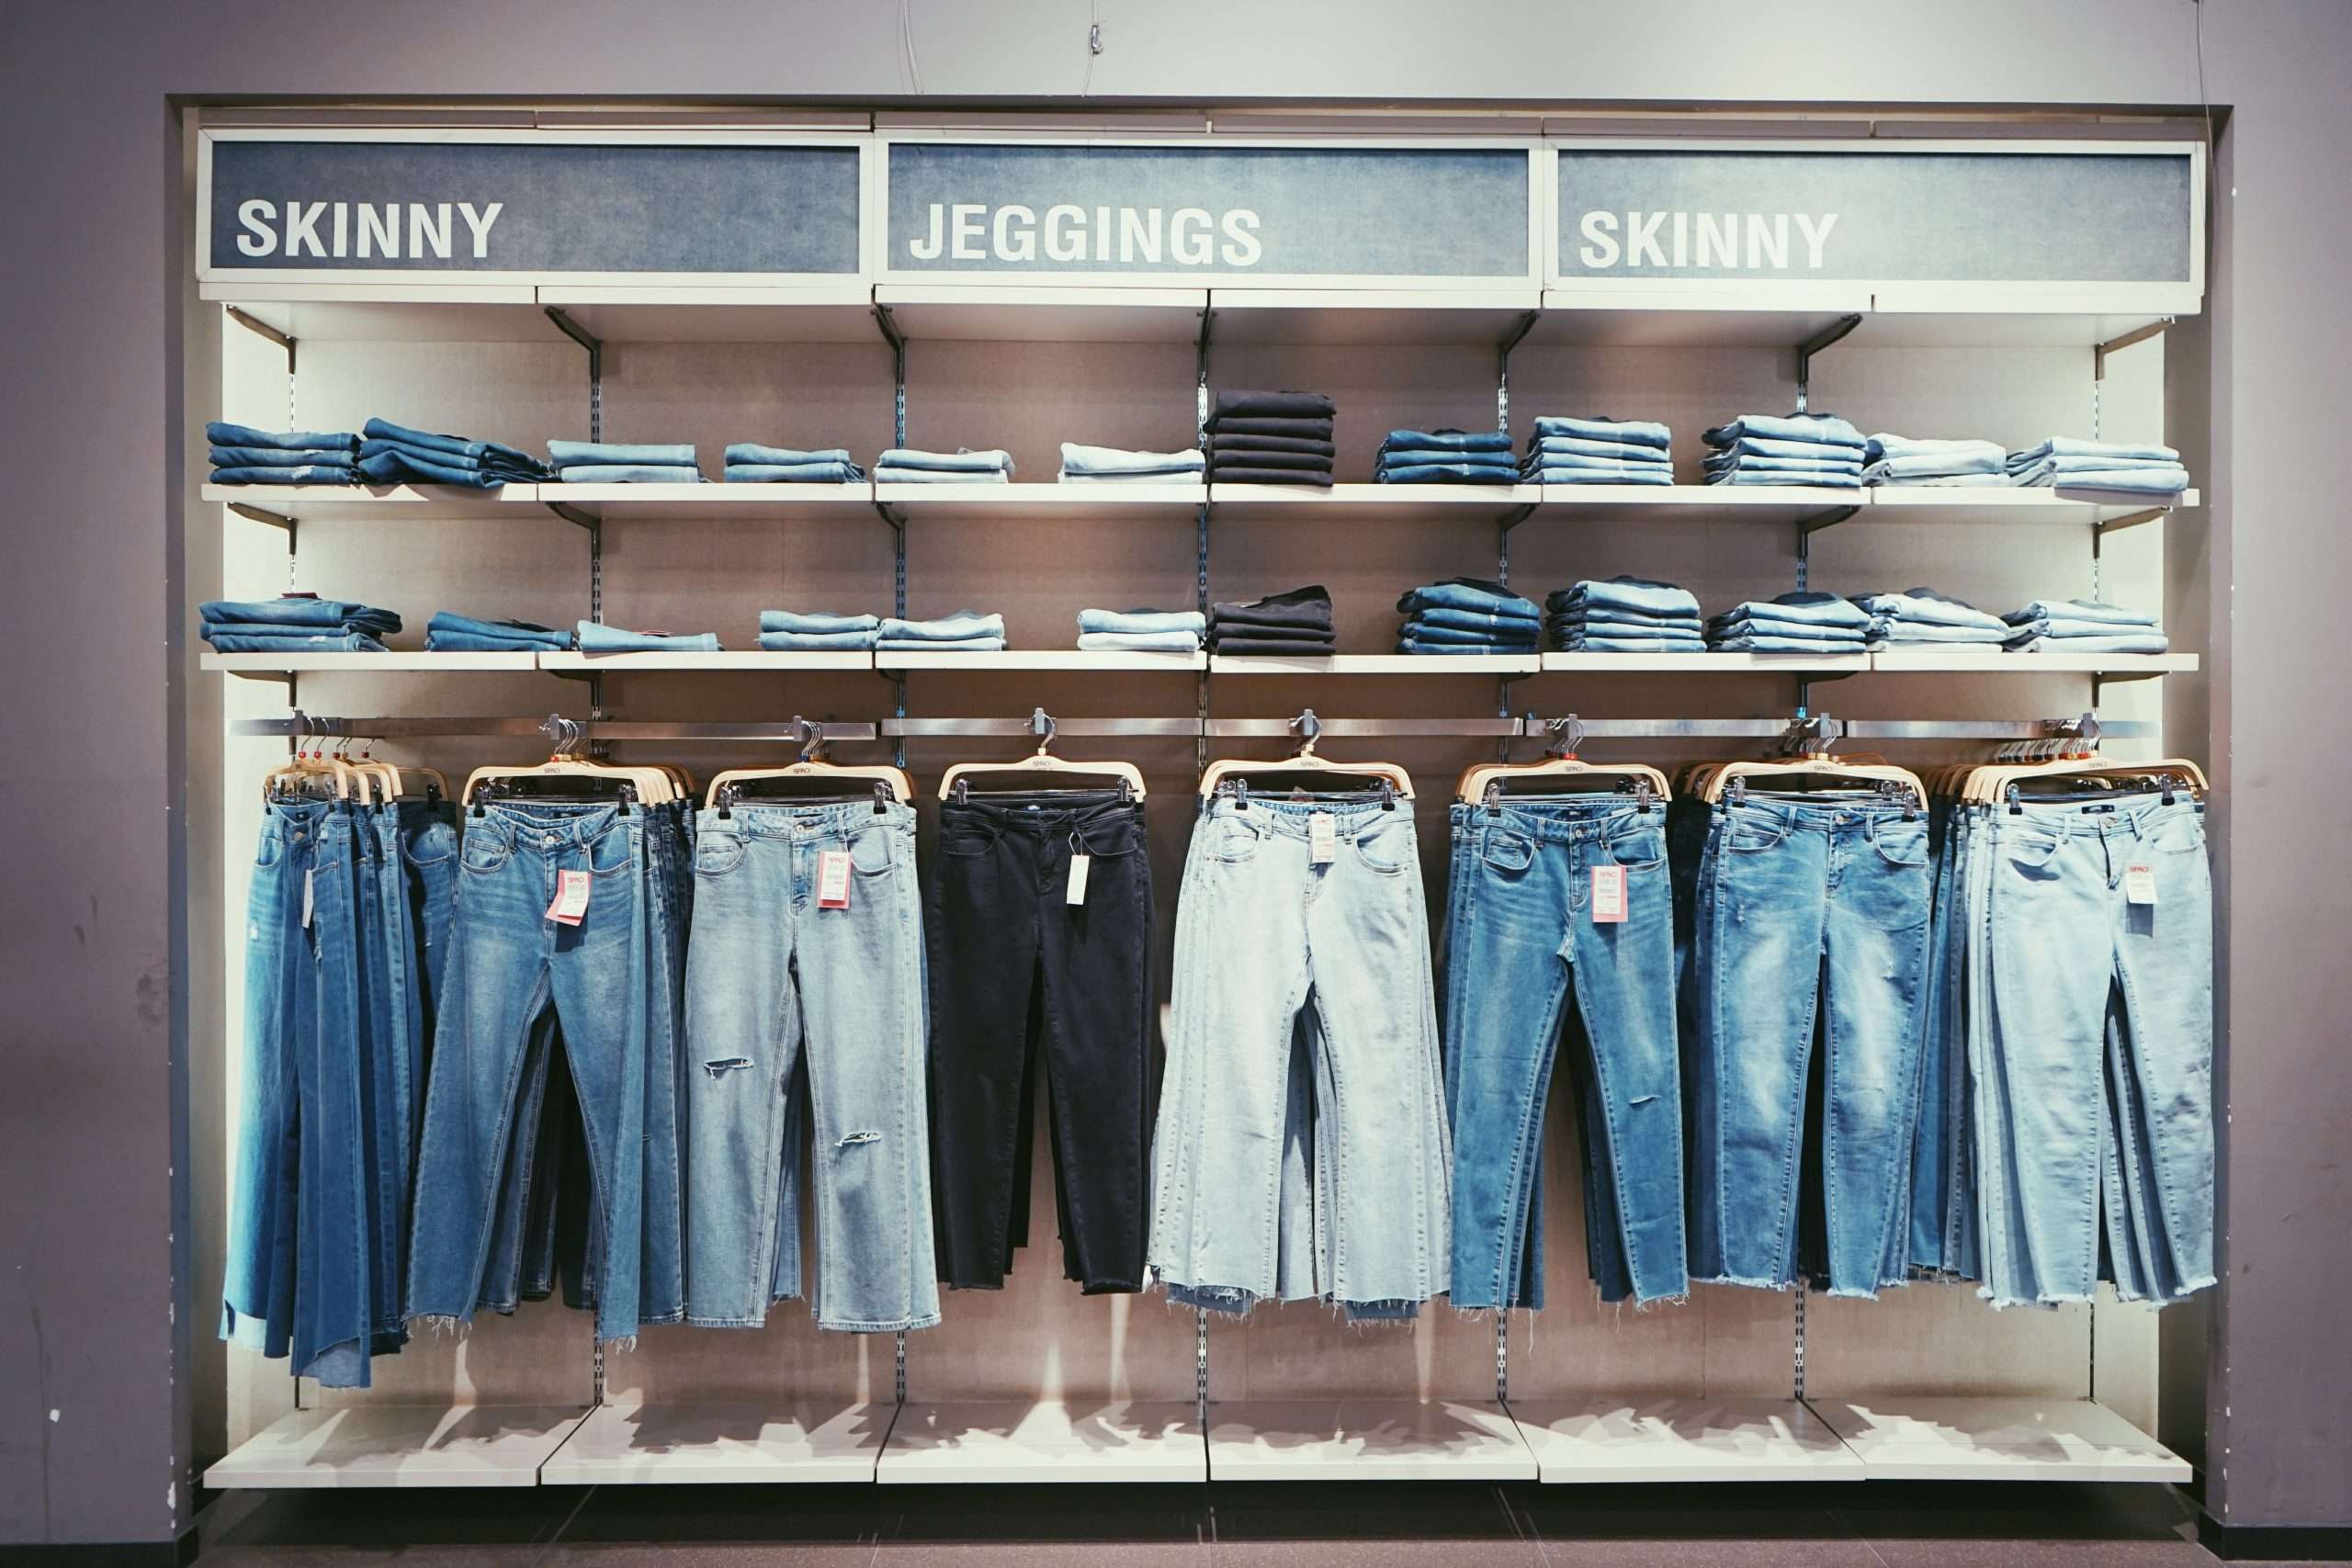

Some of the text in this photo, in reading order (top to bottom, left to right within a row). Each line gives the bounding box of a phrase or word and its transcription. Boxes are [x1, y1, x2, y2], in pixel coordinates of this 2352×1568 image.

[236, 199, 503, 258] SKINNY
[910, 203, 1262, 266] JEGGINGS
[1579, 210, 1838, 268] SKINNY
